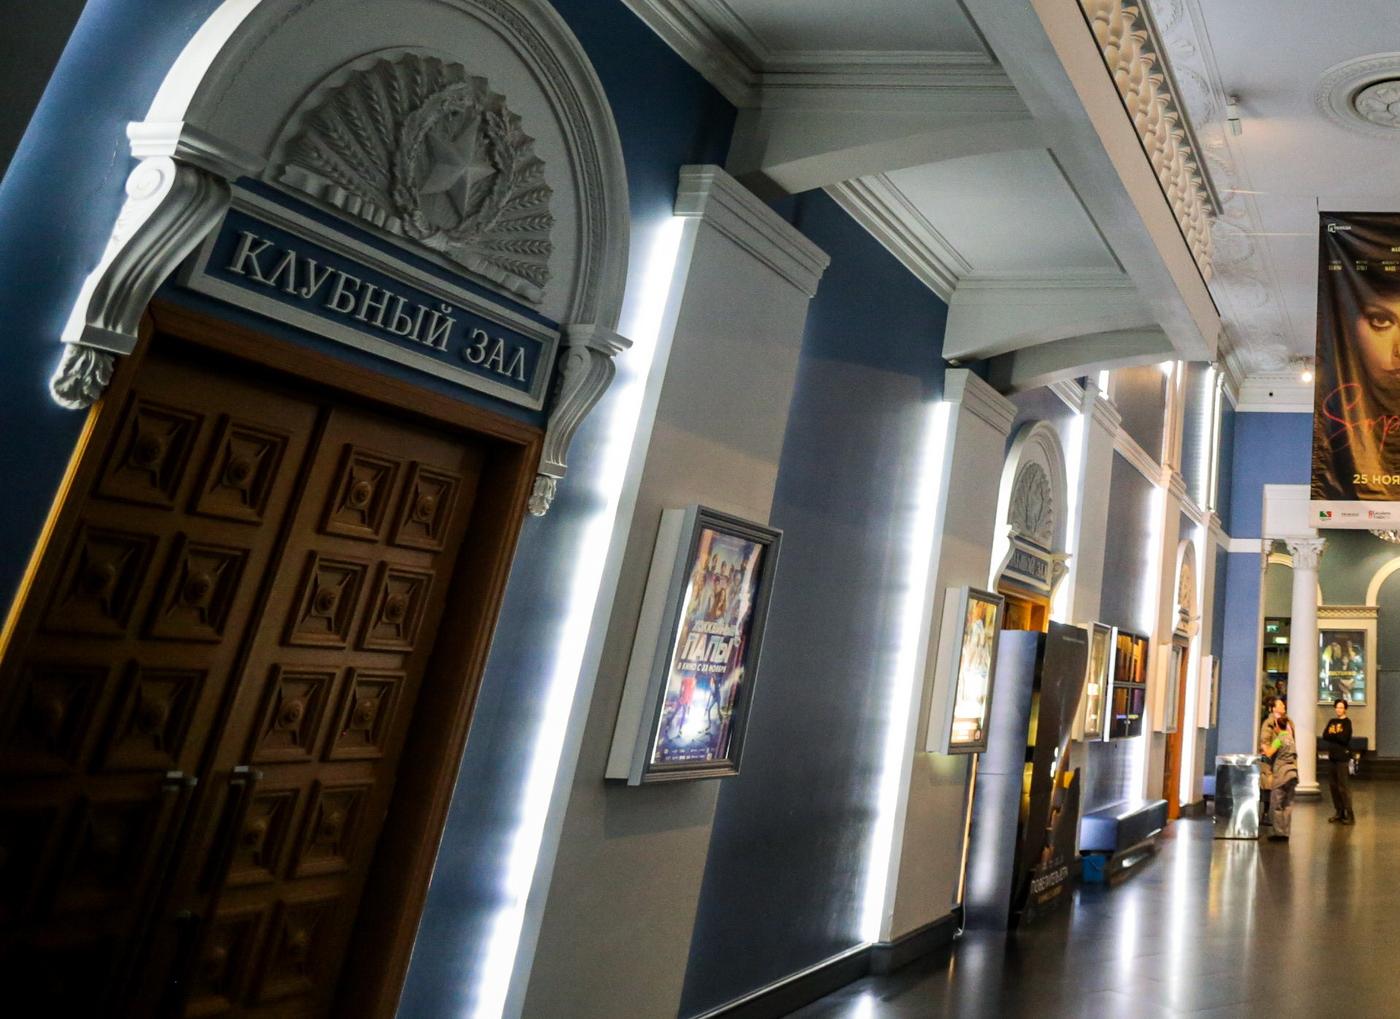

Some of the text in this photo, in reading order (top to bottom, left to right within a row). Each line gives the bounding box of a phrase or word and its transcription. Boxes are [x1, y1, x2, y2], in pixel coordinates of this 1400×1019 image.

[226, 230, 527, 382] КЛУБНЫЙ ЗАЛ
[1352, 474, 1369, 484] 25
